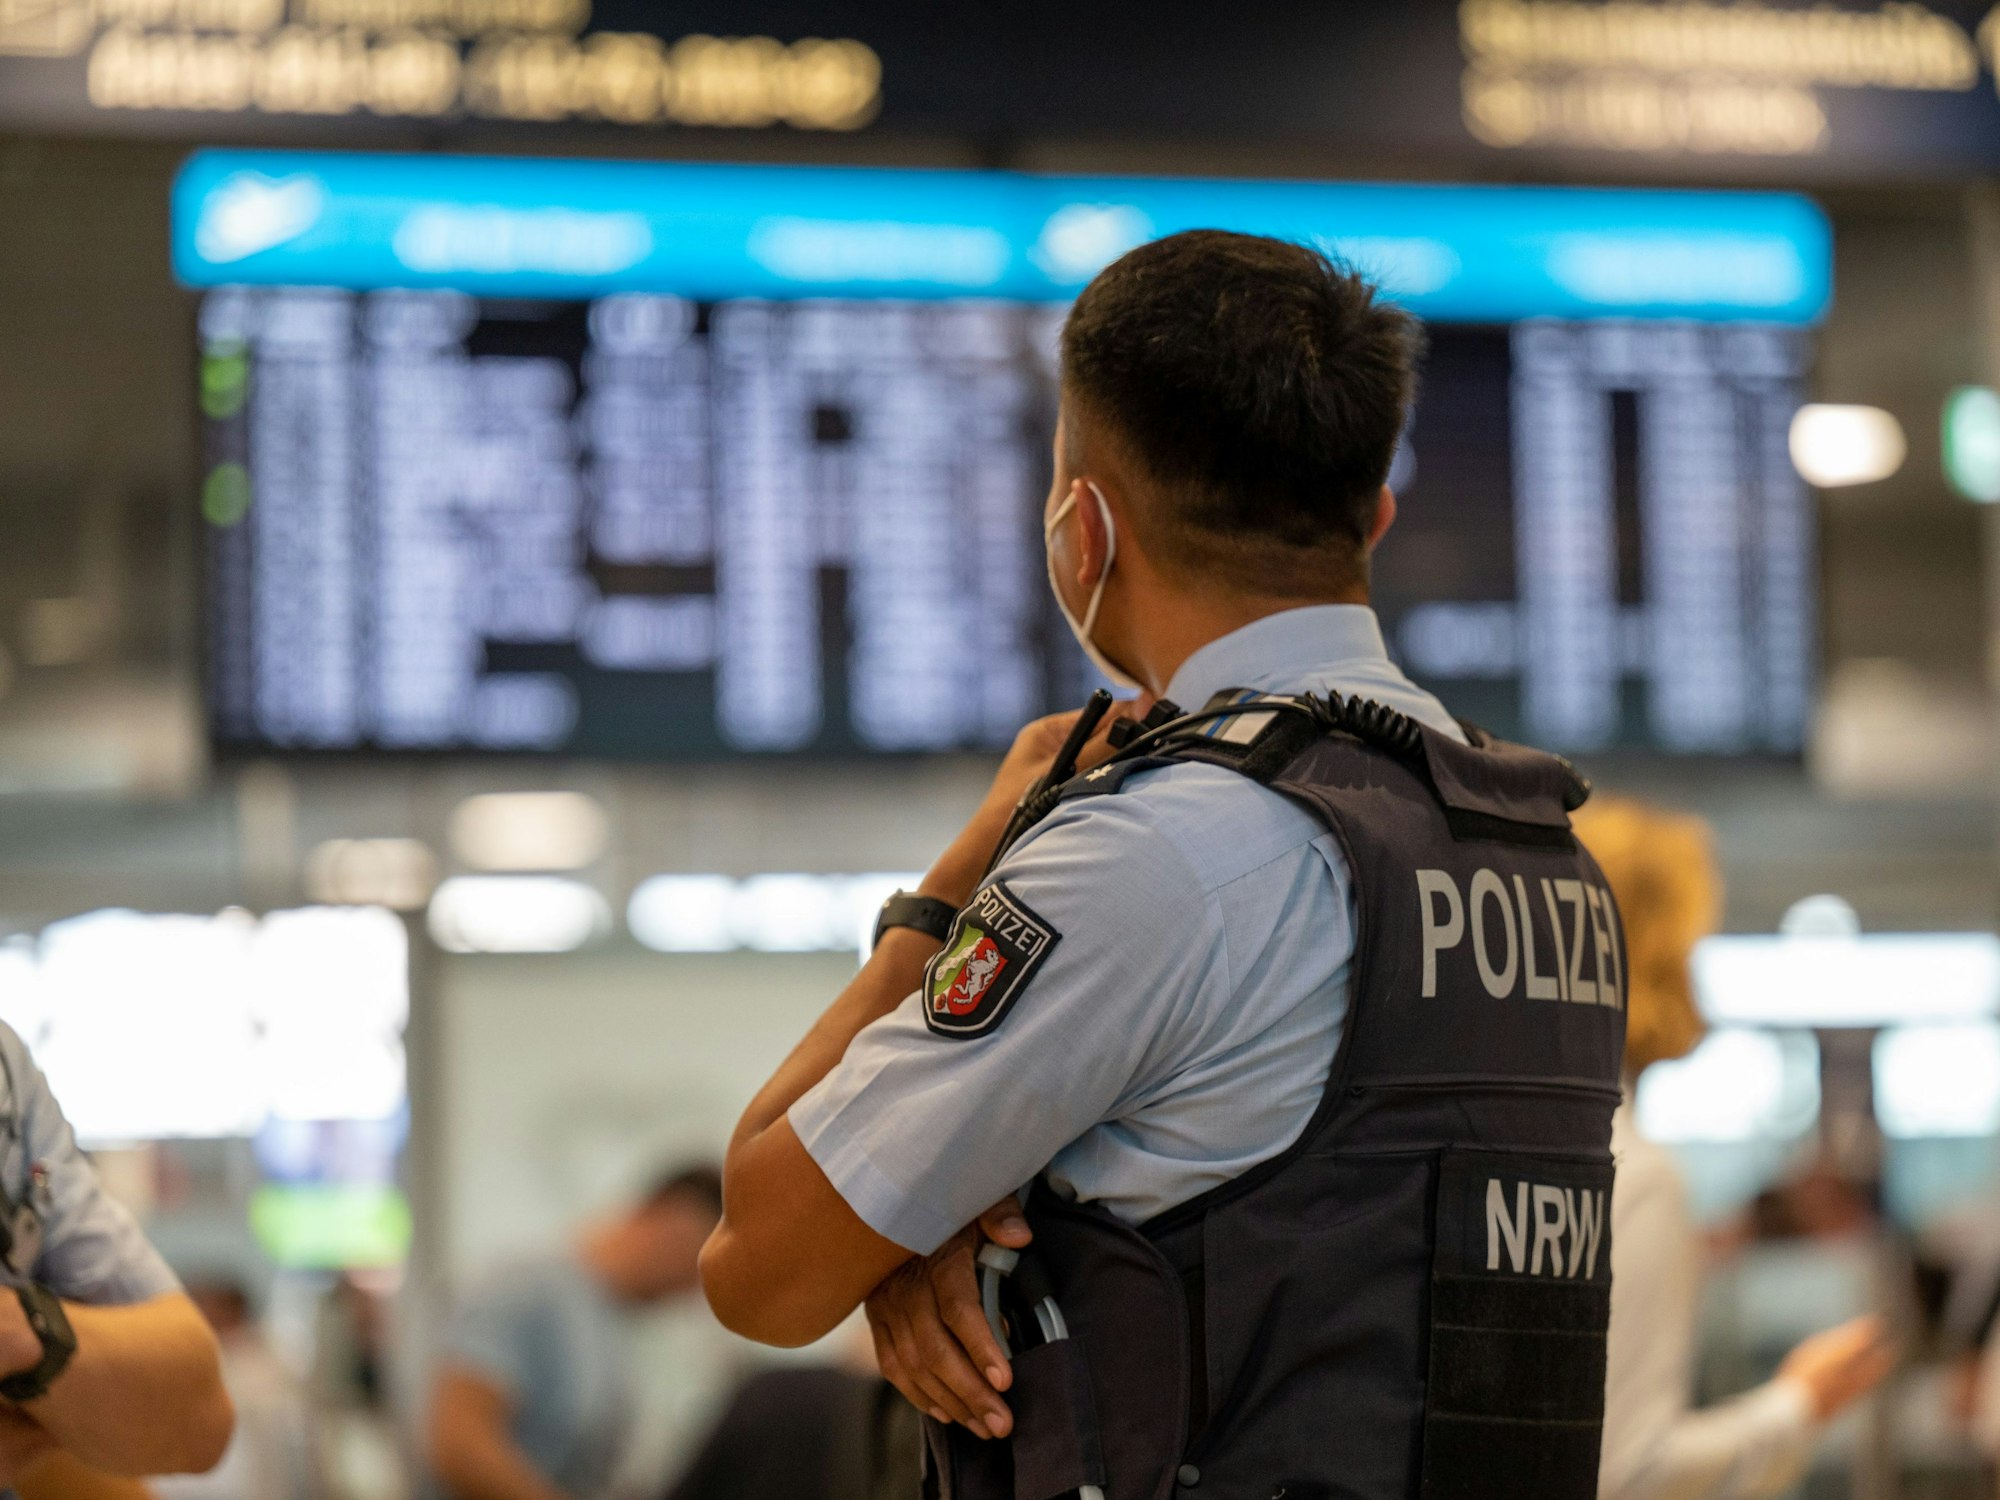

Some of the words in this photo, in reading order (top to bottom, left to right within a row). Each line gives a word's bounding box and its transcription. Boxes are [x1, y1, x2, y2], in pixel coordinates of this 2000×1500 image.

[975, 888, 1043, 956] POLIZEI
[1415, 867, 1623, 1011] POLIZEI
[1486, 1178, 1604, 1281] NRW
